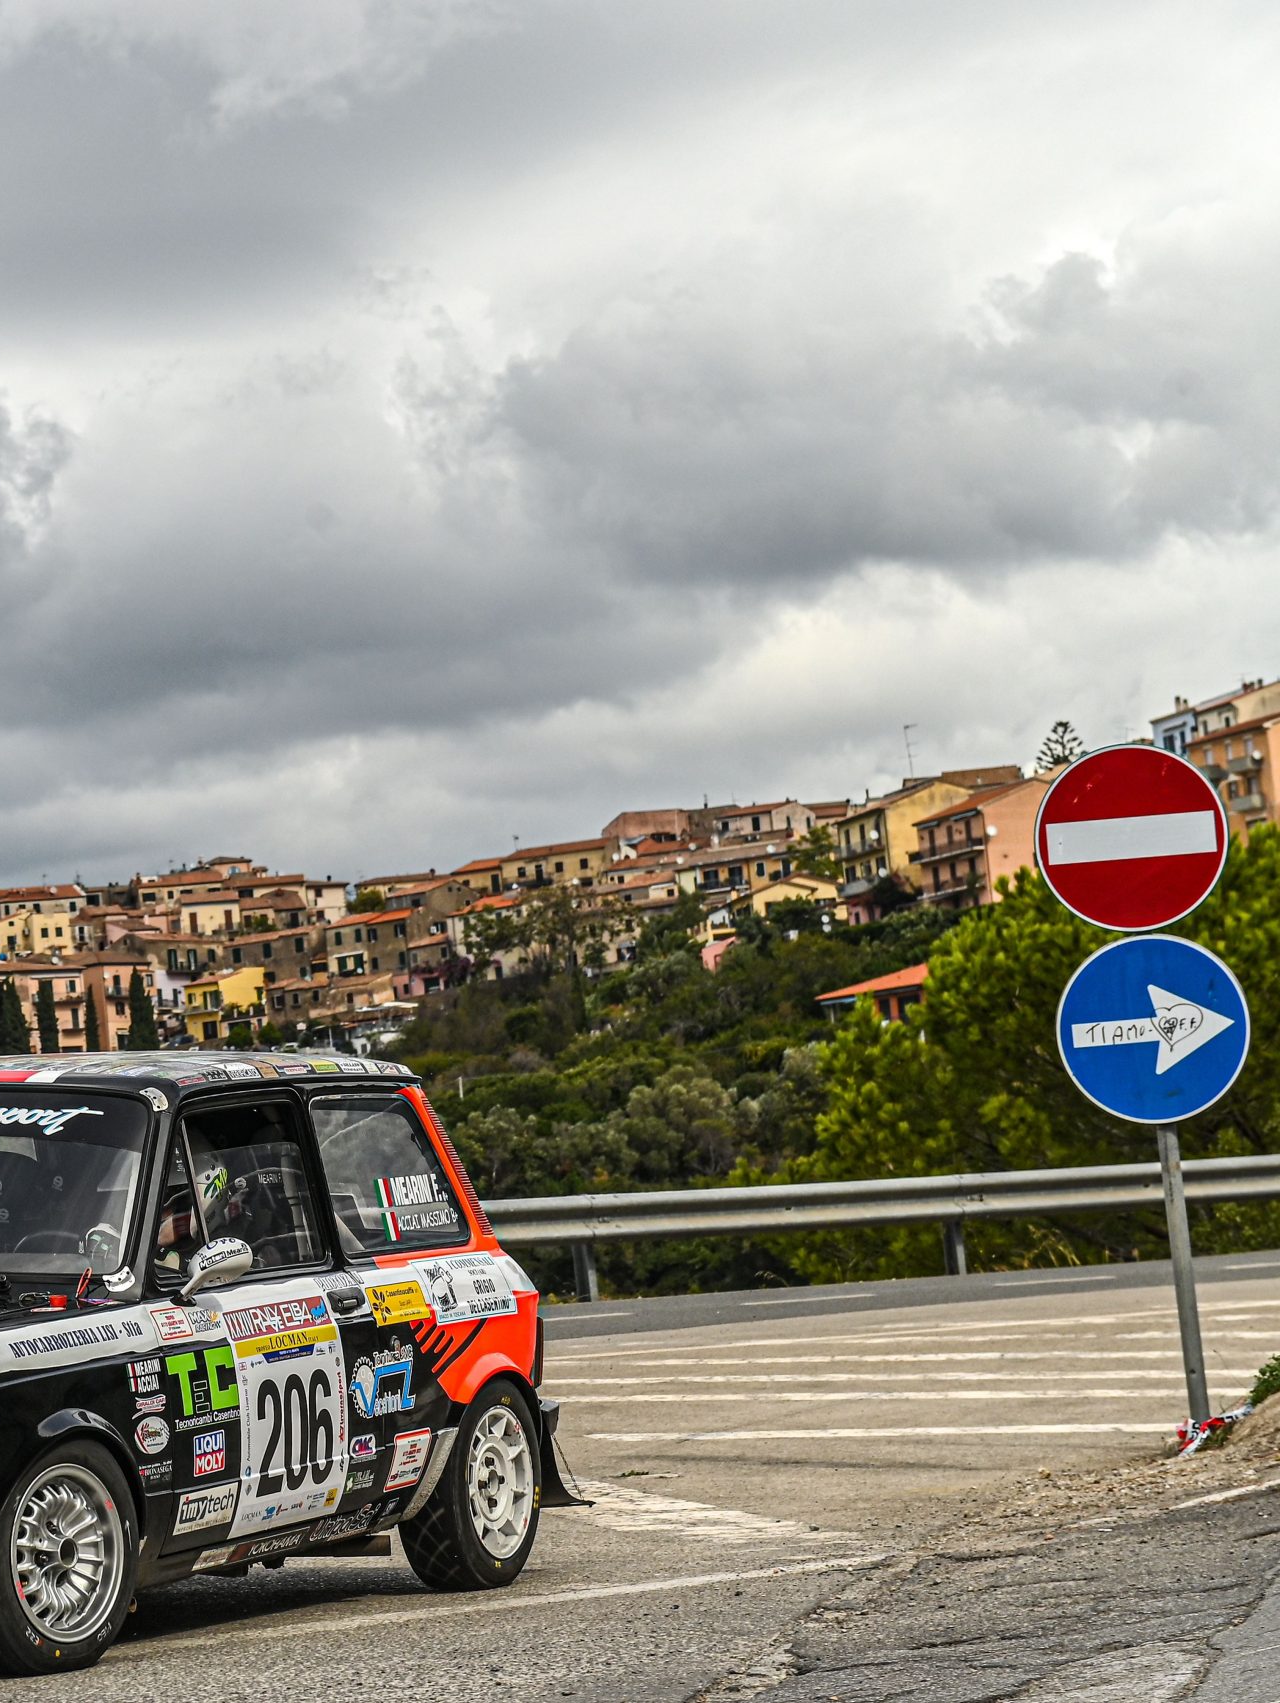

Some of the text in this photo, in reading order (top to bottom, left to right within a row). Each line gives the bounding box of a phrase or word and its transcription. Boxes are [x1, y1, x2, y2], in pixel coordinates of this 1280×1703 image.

[389, 1174, 433, 1206] MEARINI
[430, 1173, 442, 1202] F.
[397, 1213, 421, 1231] ACCIAI
[420, 1209, 451, 1229] MASSIMO
[472, 1278, 496, 1296] GRIGIO
[8, 1329, 99, 1359] AUTOCARROZZERIA
[98, 1323, 119, 1342] LISI
[121, 1320, 143, 1338] Stia
[269, 1331, 308, 1350] LOCMAN
[134, 1357, 161, 1377] MEARINI
[137, 1373, 160, 1394] ACCIAI
[175, 1414, 213, 1430] Tecnoricambi
[255, 1368, 334, 1498] 206
[195, 1433, 223, 1455] LIQUI
[195, 1451, 224, 1474] MOLY
[247, 1533, 300, 1556] YOKOHAMA
